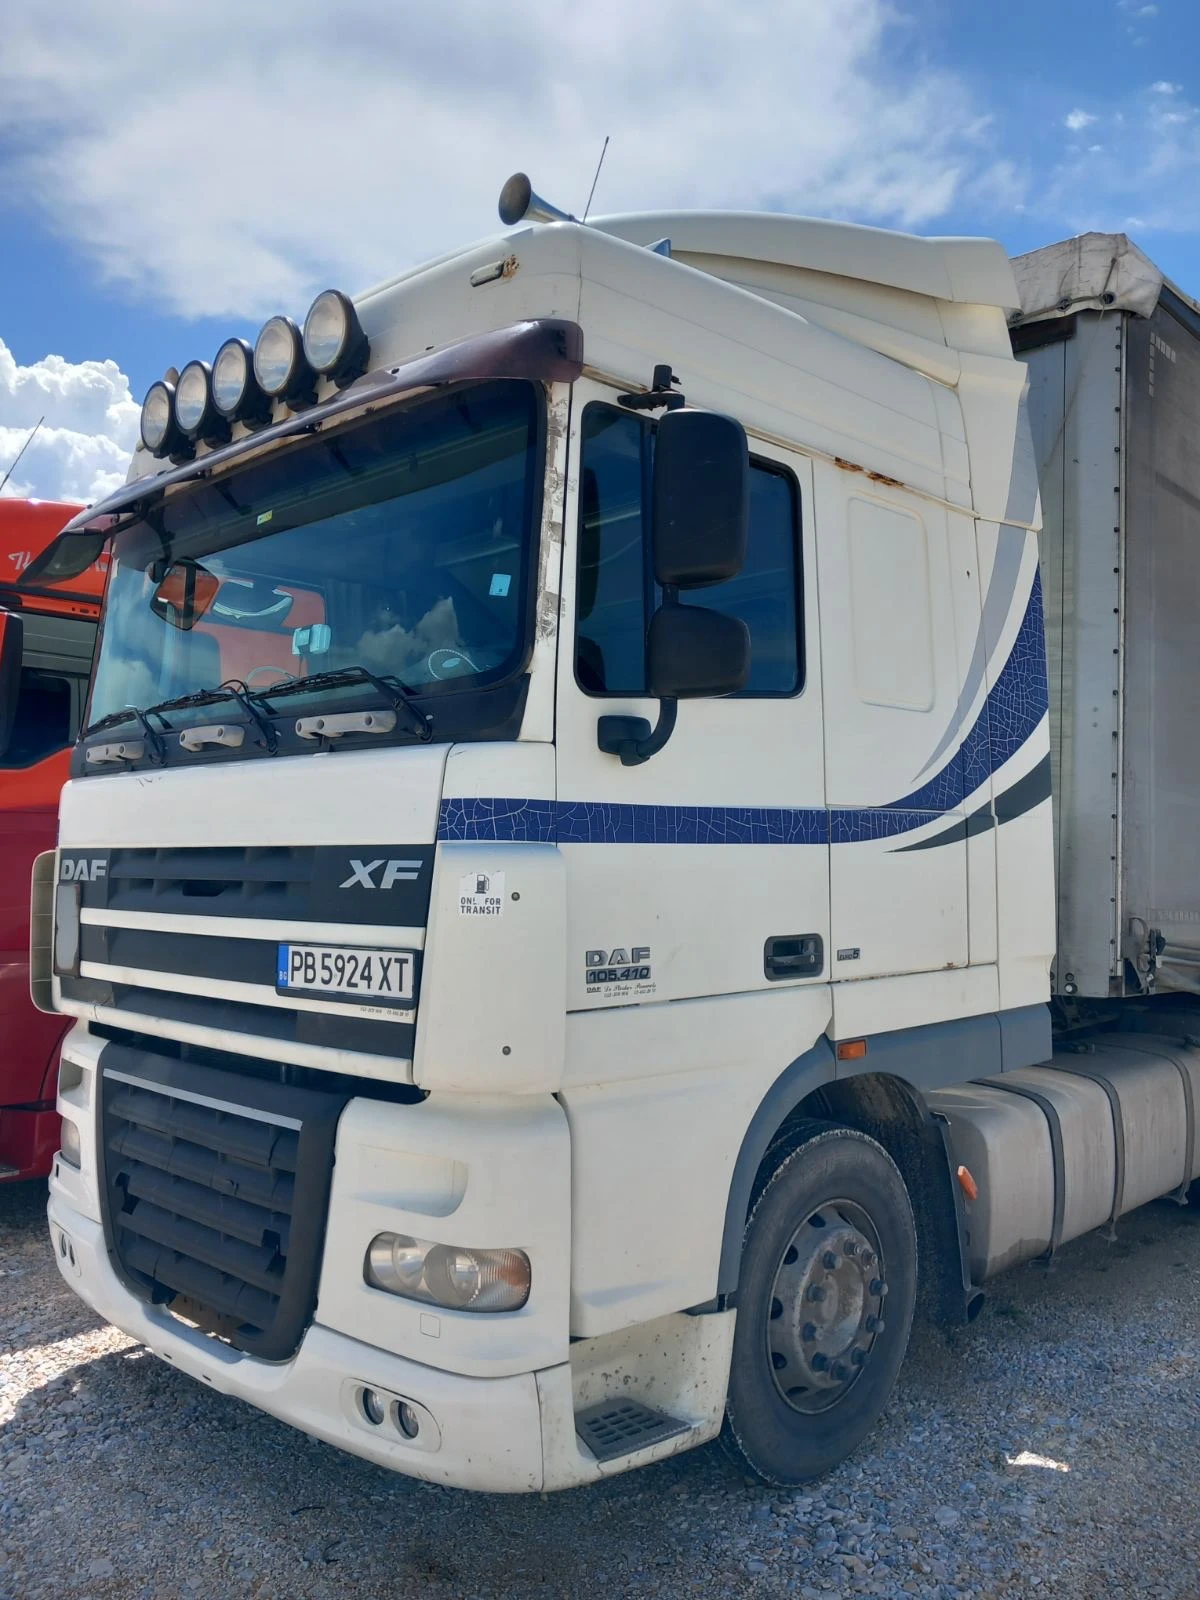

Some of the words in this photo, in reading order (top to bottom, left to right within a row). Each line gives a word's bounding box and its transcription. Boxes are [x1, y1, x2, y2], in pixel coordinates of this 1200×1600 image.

[60, 859, 107, 881] DAF
[339, 859, 423, 889] XF
[460, 905, 501, 915] TRANSIT
[484, 897, 501, 906] FOR
[585, 947, 651, 967] DAF
[588, 966, 650, 983] 105.410
